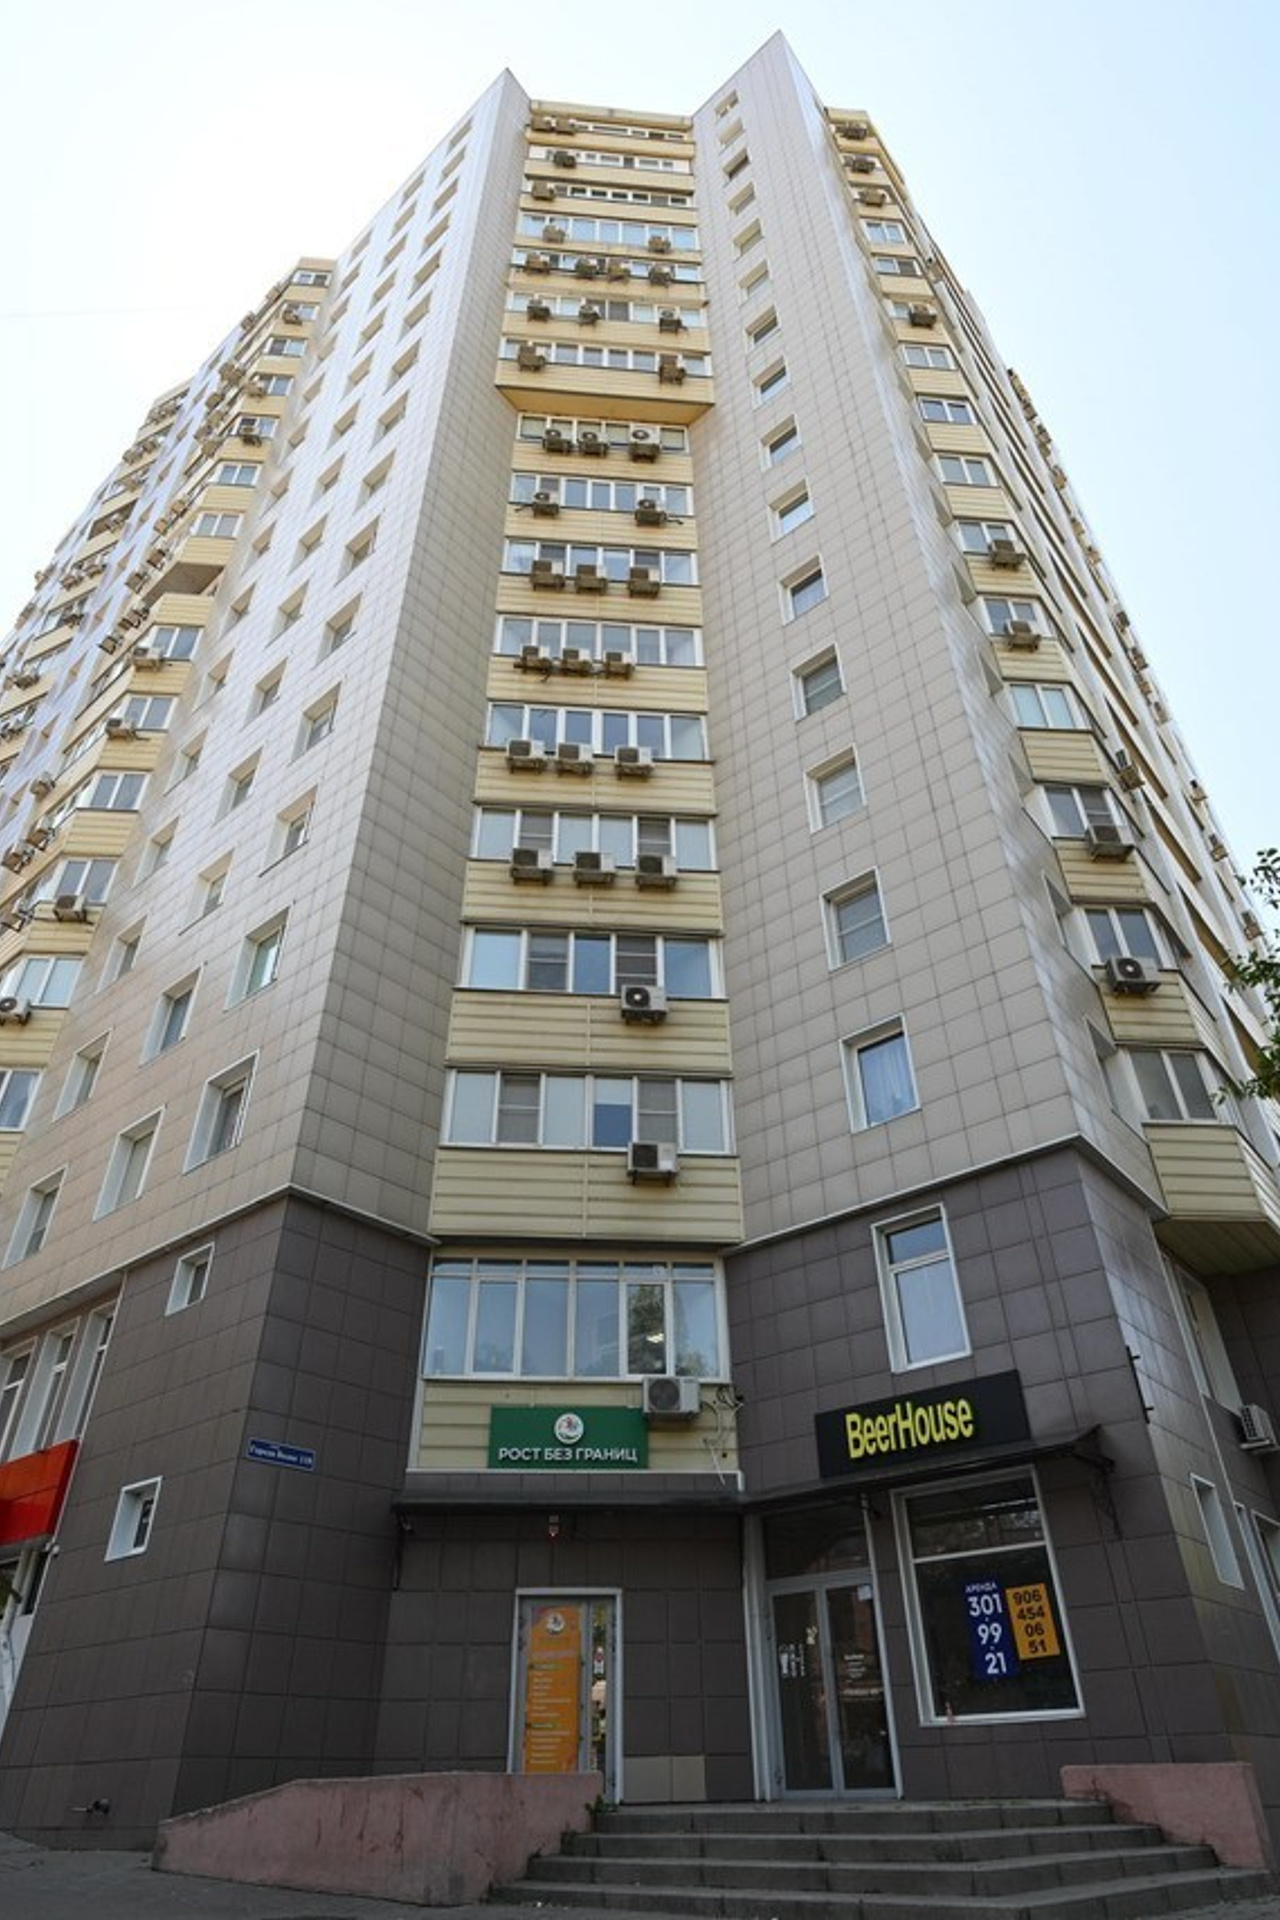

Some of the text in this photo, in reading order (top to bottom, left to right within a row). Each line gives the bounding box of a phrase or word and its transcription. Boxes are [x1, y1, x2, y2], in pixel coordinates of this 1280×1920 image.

[845, 1397, 974, 1459] BeerHouse
[498, 1447, 638, 1463] РОСТ БЕЗ ГРАНИЦ
[965, 1582, 997, 1593] АРЕНДА
[1013, 1590, 1042, 1604] 906
[967, 1593, 1003, 1617] 301
[1017, 1605, 1045, 1620] 454
[977, 1622, 1002, 1645] 99
[1025, 1622, 1045, 1637] 06
[1029, 1639, 1047, 1654] 51
[985, 1652, 1007, 1675] 21
